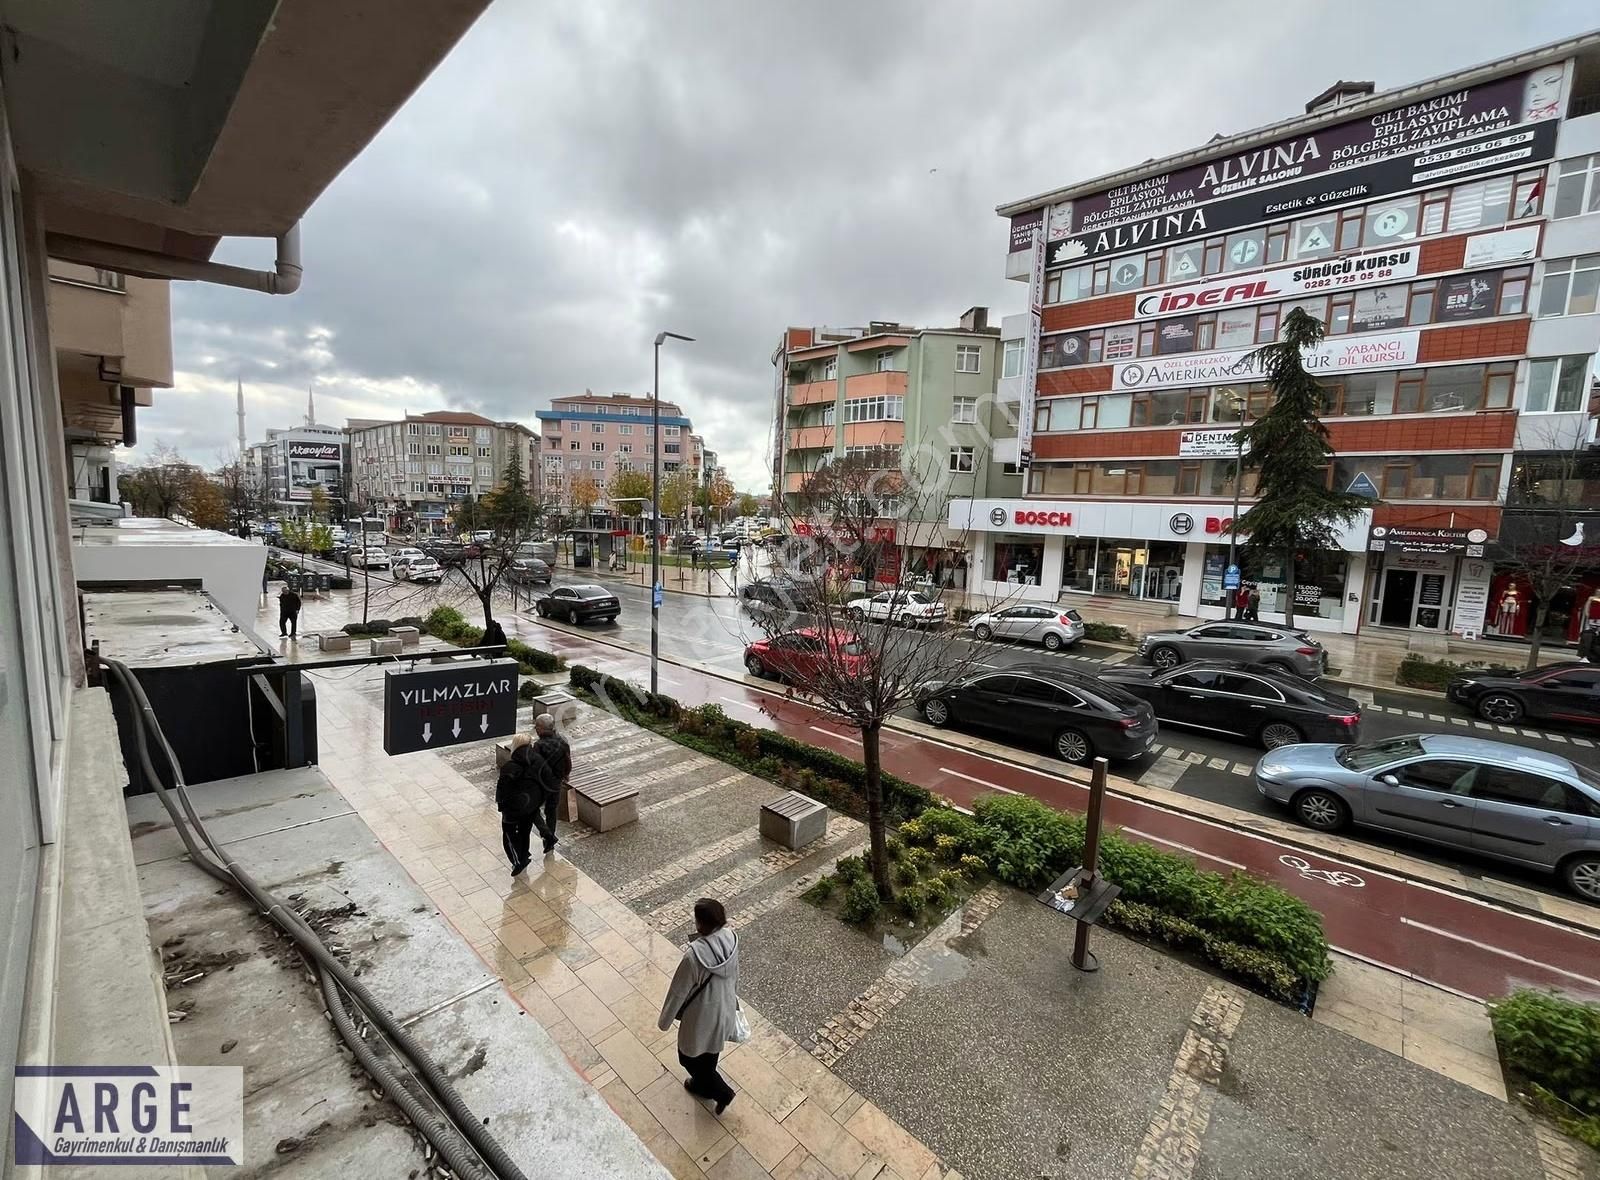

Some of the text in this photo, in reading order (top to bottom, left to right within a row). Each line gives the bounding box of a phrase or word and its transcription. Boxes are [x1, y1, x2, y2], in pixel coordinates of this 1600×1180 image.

[1407, 90, 1470, 117] BAKIMI
[1331, 106, 1509, 161] BÖLGESEL ZAYIFLAMA
[1455, 120, 1511, 140] SEANSI
[1508, 134, 1527, 146] 59
[1198, 137, 1321, 189] ALVINA
[1130, 175, 1170, 193] BAKIMI
[1258, 166, 1303, 184] SALONU
[1083, 189, 1195, 224] BÖLGESEL ZAYIFLAMA
[1265, 184, 1368, 214] Estetik & Güzellik
[1093, 208, 1207, 254] ALVINA
[1293, 252, 1411, 282] SÜRÜCÜ KURSU
[1304, 268, 1392, 289] 0282 725 05 88
[1338, 351, 1405, 366] DİL KURSU
[1345, 341, 1402, 355] YABANCI
[290, 445, 337, 457] Aksoylar
[1014, 510, 1072, 528] BOSCH
[400, 679, 511, 706] YILMAZLAR
